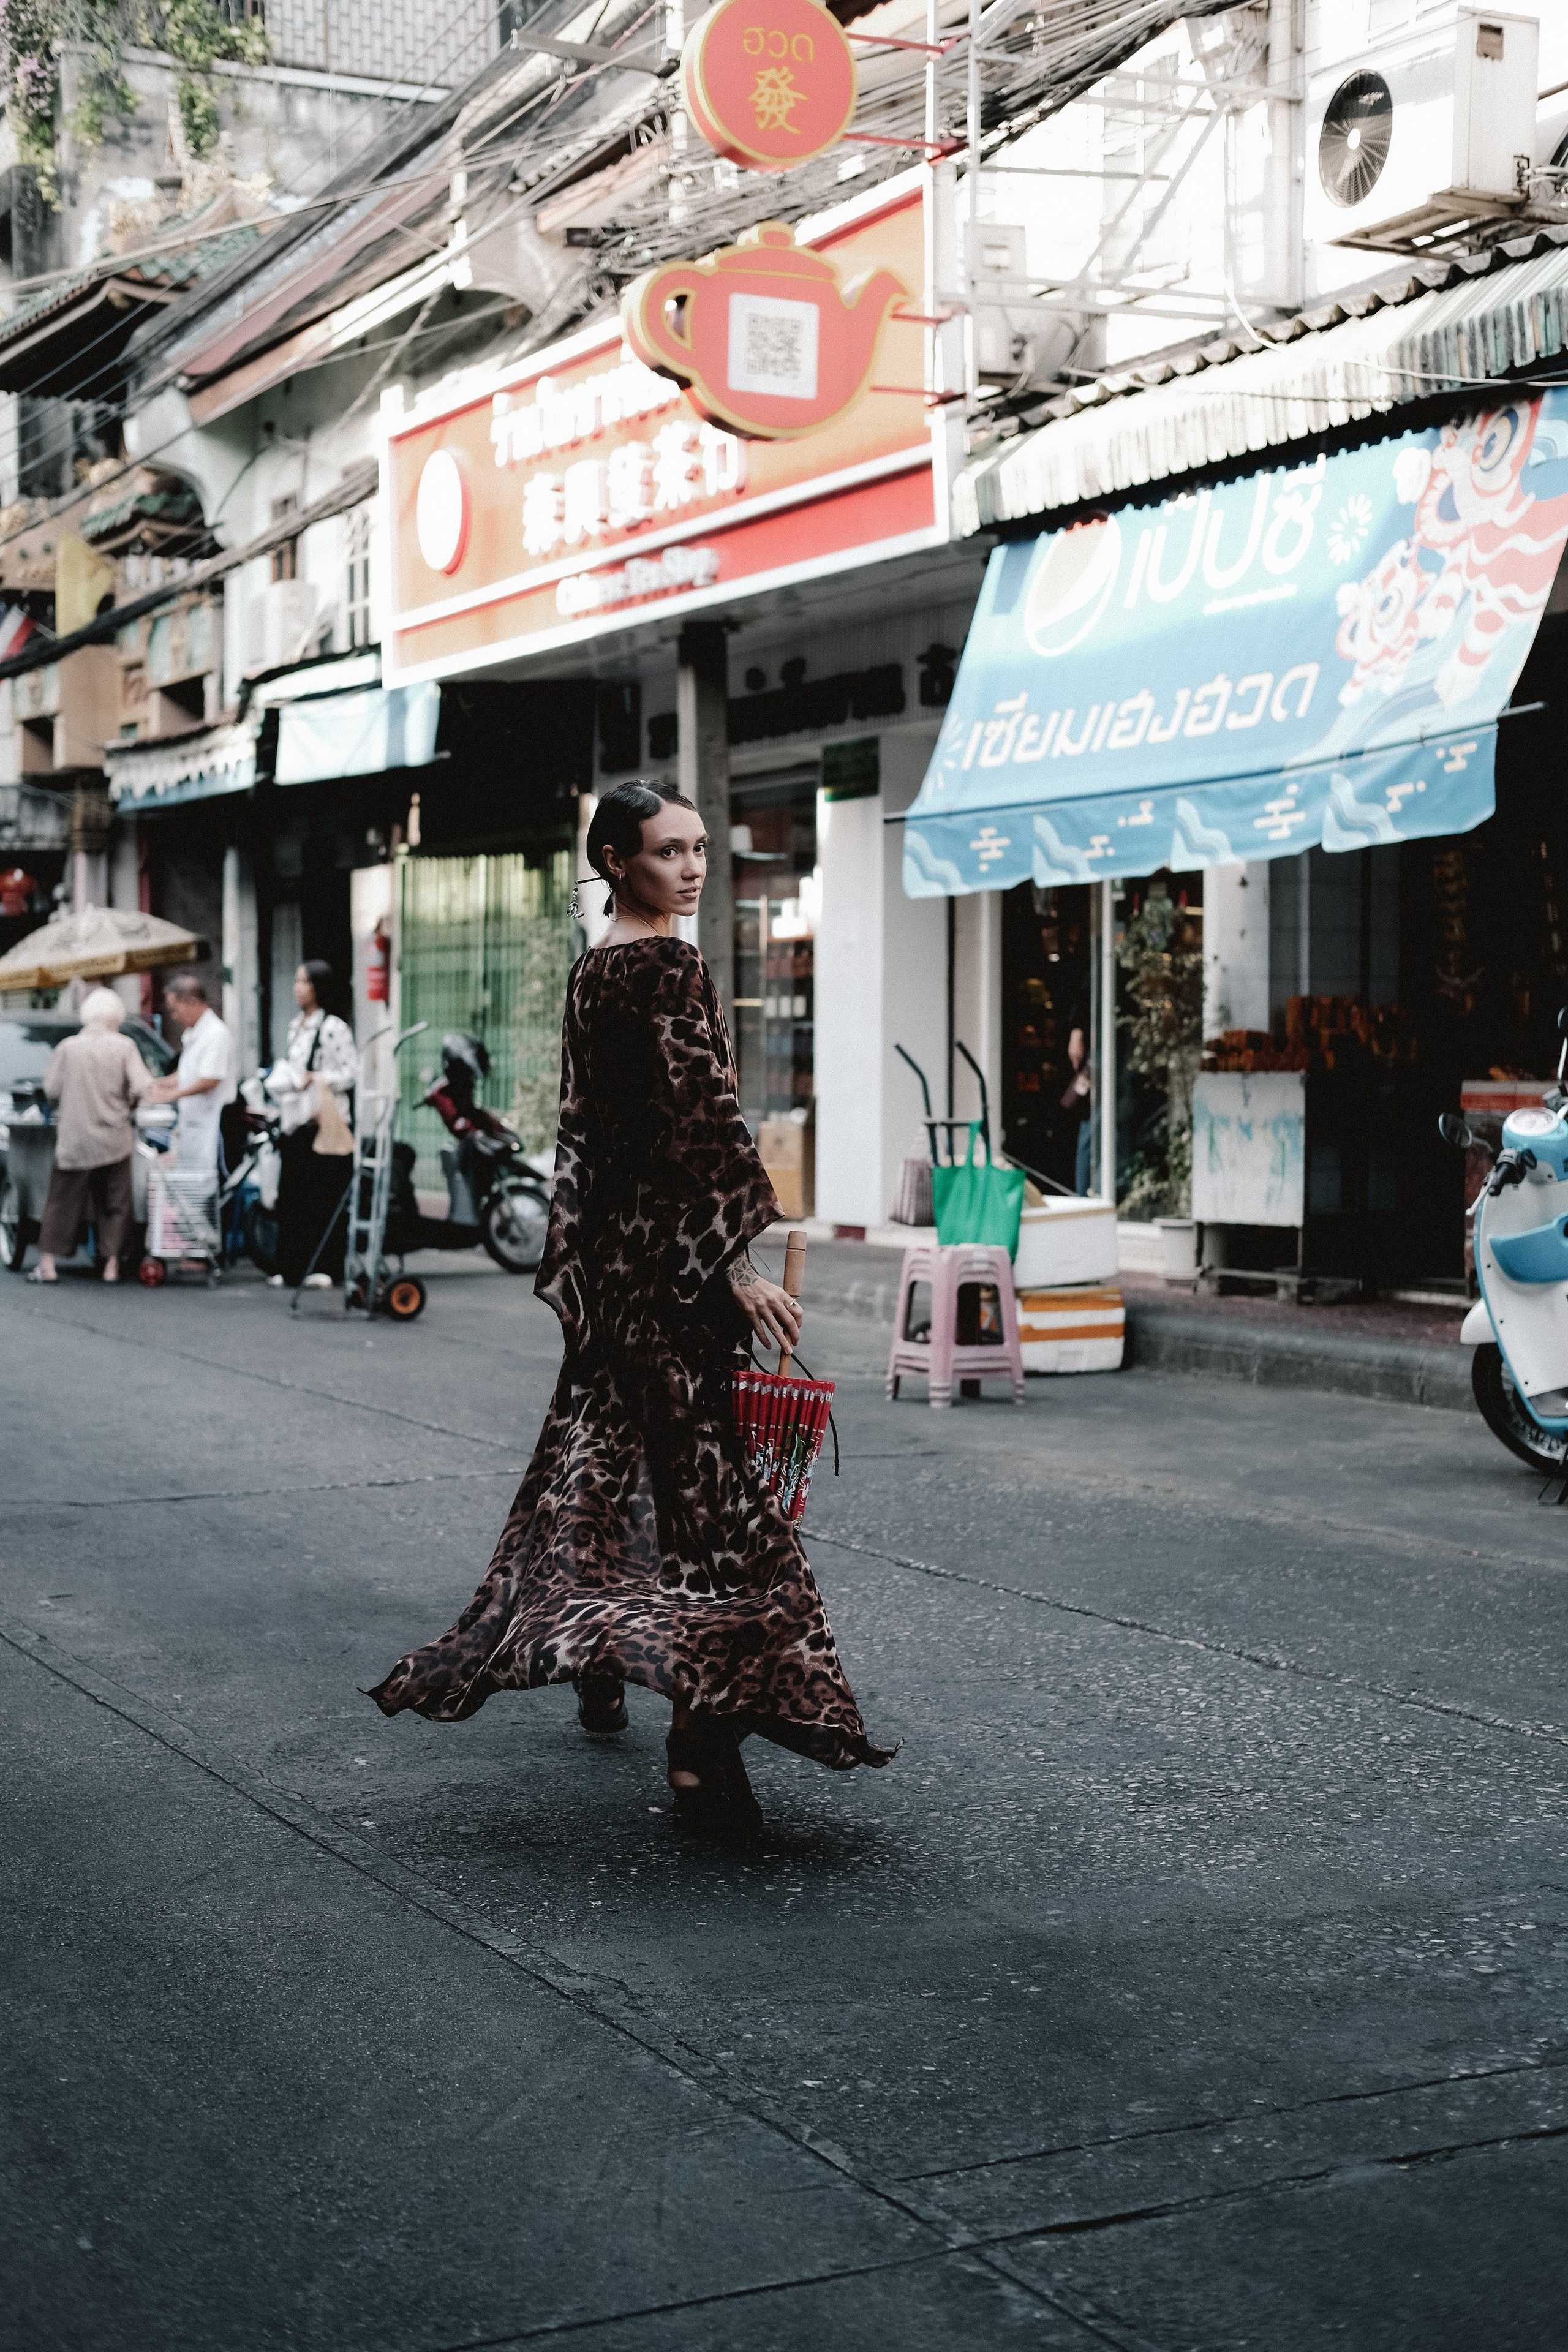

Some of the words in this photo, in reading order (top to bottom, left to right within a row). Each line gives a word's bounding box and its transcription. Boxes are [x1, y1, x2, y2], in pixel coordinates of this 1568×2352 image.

[741, 25, 815, 62] ฮวด
[747, 65, 810, 135] 發
[961, 662, 1321, 770] เซียมเฮงฮวด
